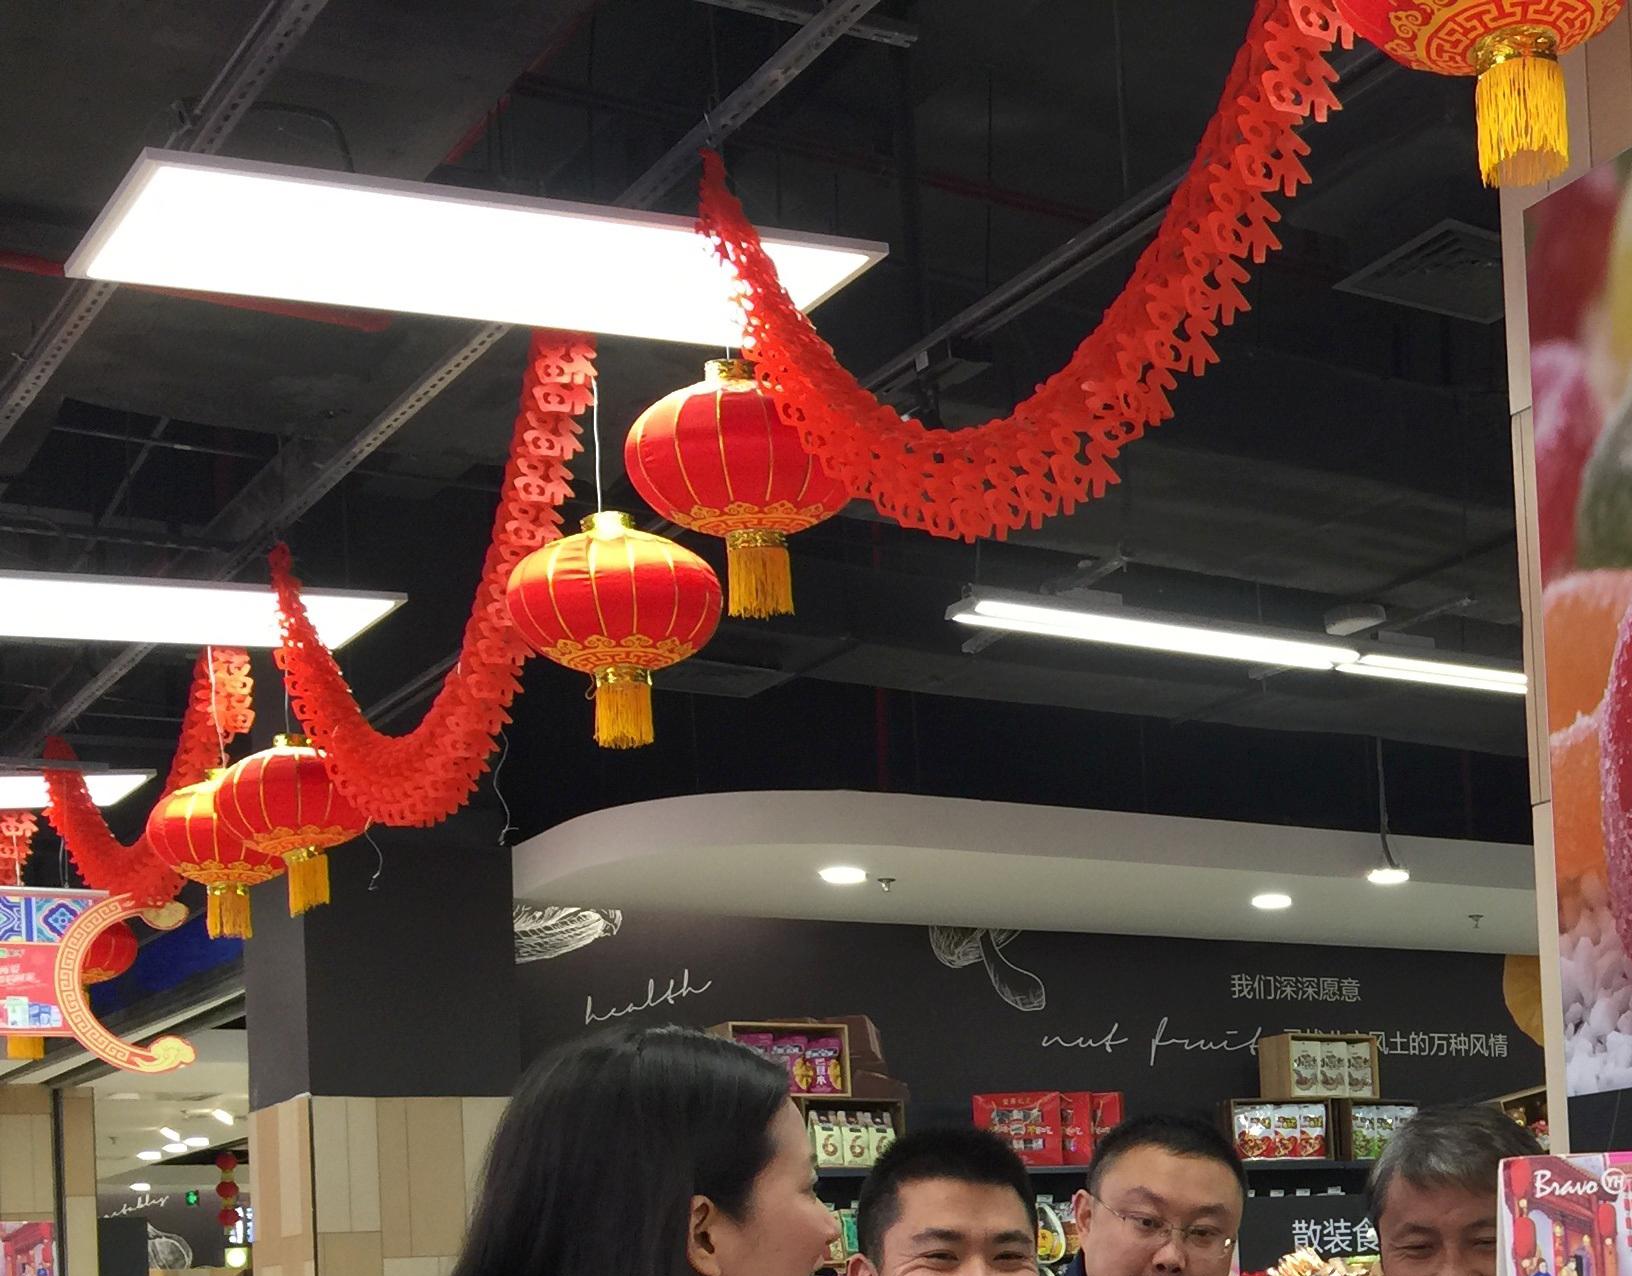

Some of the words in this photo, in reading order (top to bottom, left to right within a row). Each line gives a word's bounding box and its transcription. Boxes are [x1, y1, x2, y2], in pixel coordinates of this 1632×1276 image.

[584, 967, 713, 1025] health
[1229, 972, 1362, 1003] 我们深深愿意
[1040, 1021, 1128, 1054] nut
[1149, 1016, 1264, 1067] fruit
[1534, 1169, 1599, 1199] Bravo
